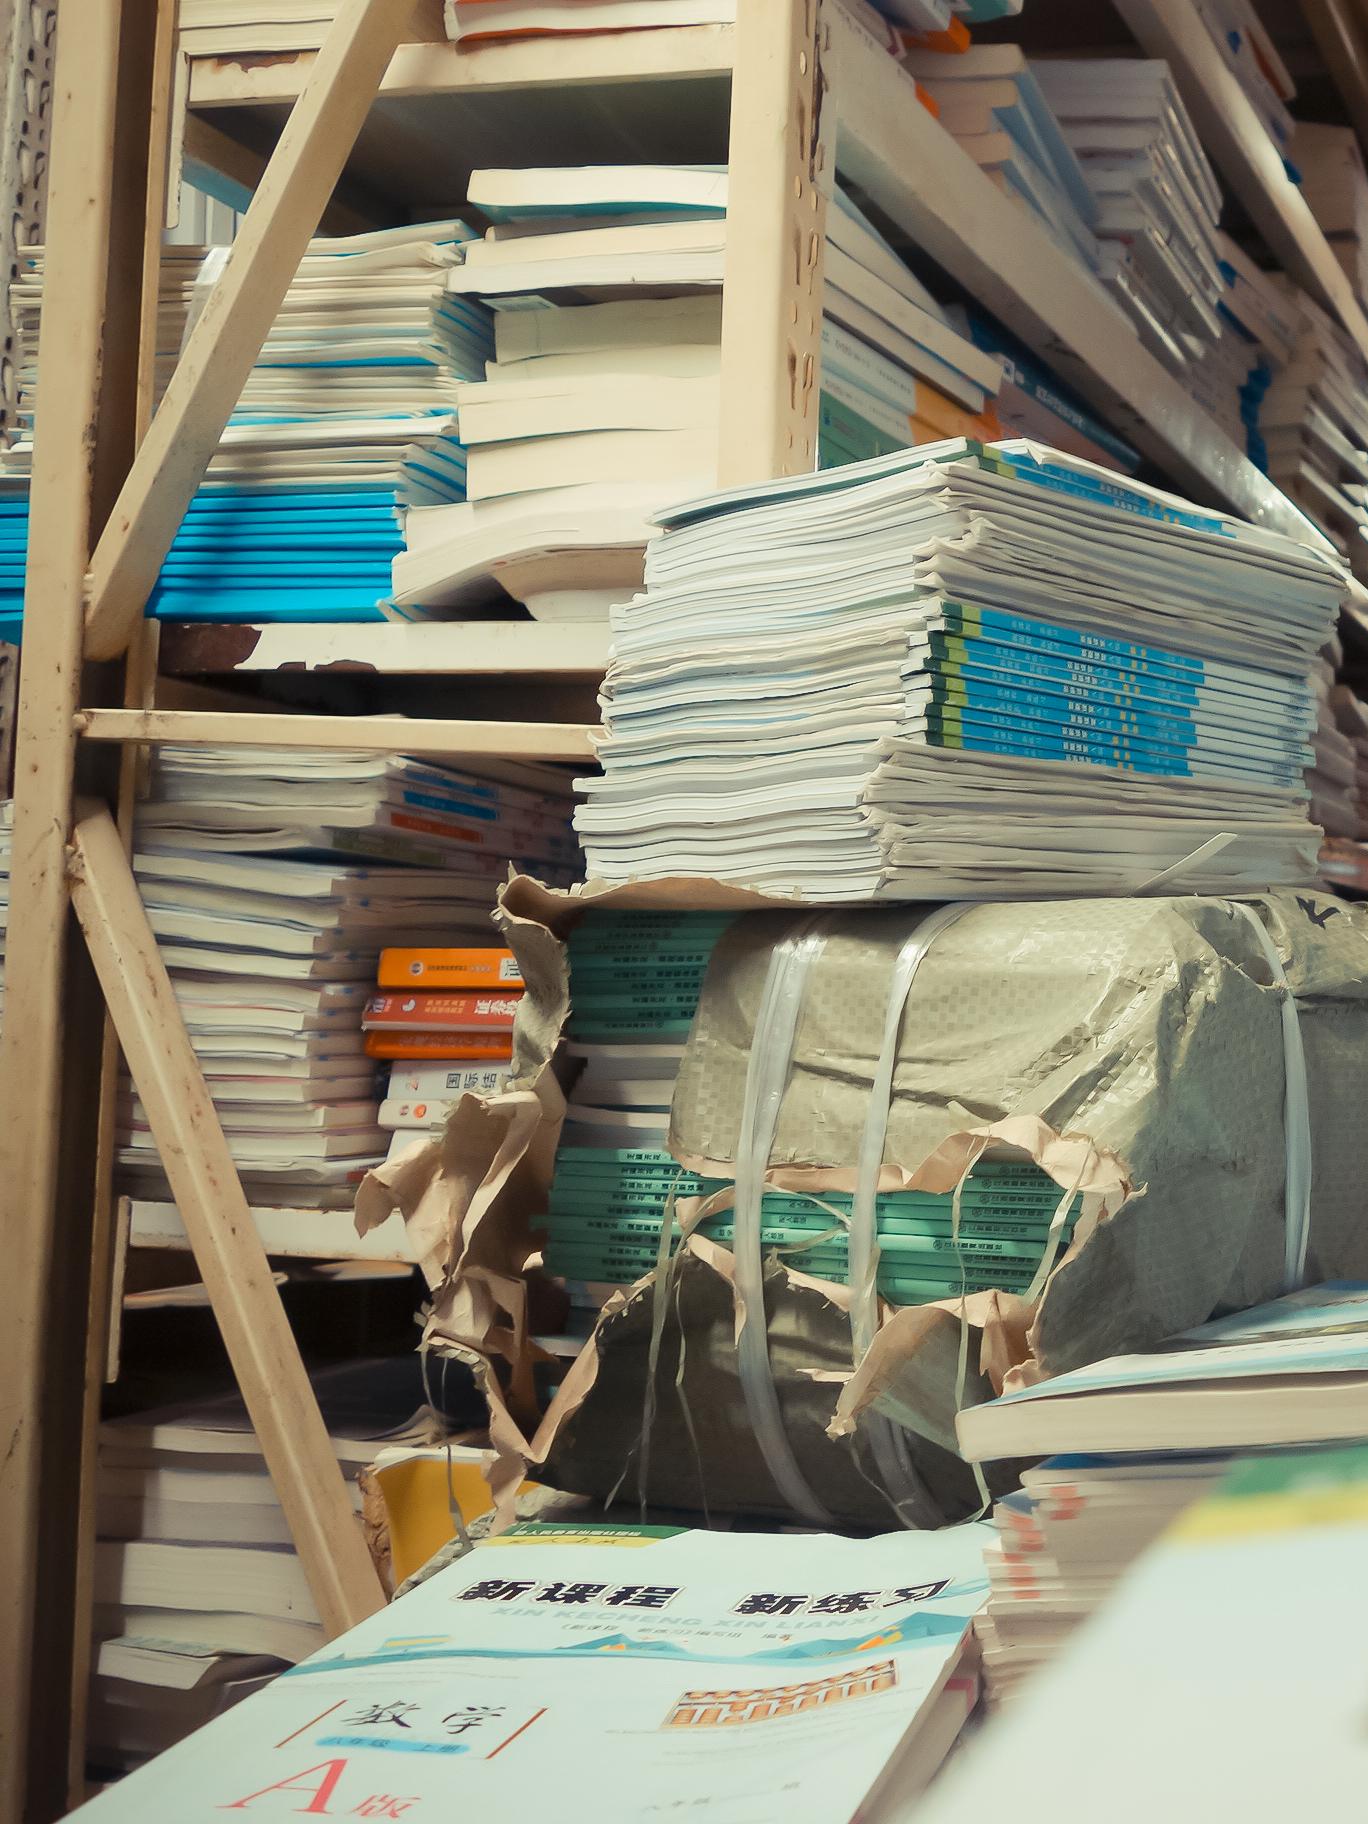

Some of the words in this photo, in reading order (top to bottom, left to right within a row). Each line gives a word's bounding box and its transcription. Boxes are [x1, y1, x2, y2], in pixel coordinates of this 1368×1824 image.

[457, 1578, 687, 1609] 新课程
[736, 1578, 952, 1615] 新练习
[493, 1606, 547, 1617] XIN
[553, 1609, 703, 1626] KECHENG
[715, 1619, 768, 1630] XIN
[776, 1615, 879, 1630] LIANXI
[341, 1701, 507, 1735] 数学
